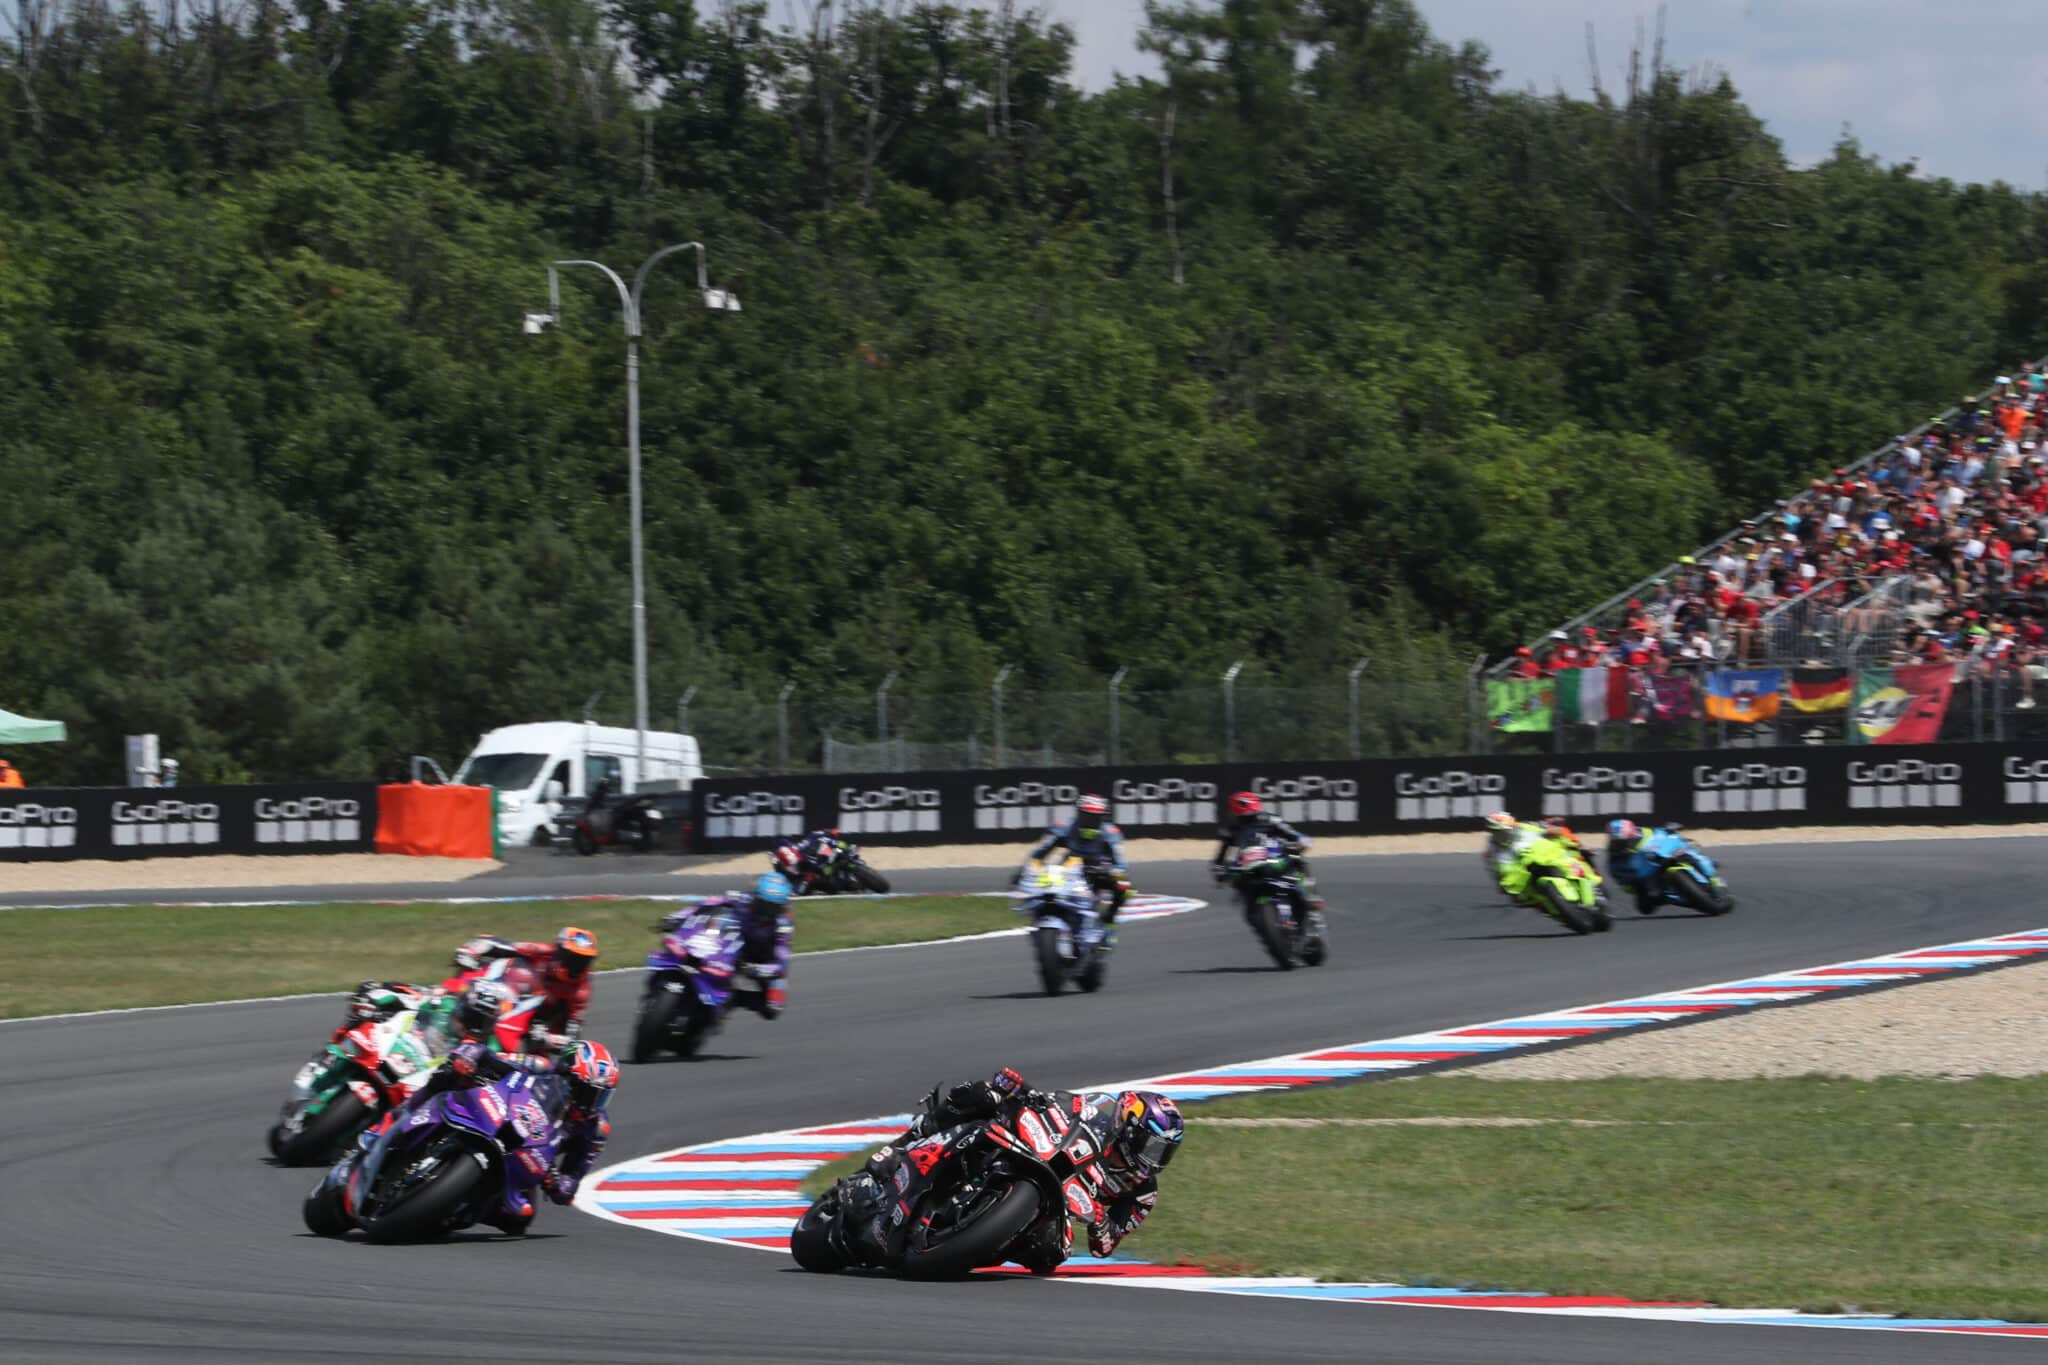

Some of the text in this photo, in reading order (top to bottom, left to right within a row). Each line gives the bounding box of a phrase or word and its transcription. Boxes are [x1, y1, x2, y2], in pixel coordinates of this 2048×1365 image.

[1543, 767, 1653, 791] GoPro
[1694, 763, 1806, 788] GoPro
[1847, 759, 1962, 783] GoPro
[974, 782, 1079, 805] GoPro
[1113, 778, 1217, 802] GoPro
[1251, 775, 1358, 799] GoPro
[1397, 771, 1505, 796] GoPro
[255, 797, 359, 820] GoPro
[706, 792, 803, 815] GoPro
[839, 786, 941, 811] GoPro
[0, 803, 77, 825] oPro
[111, 800, 219, 823] GoPro
